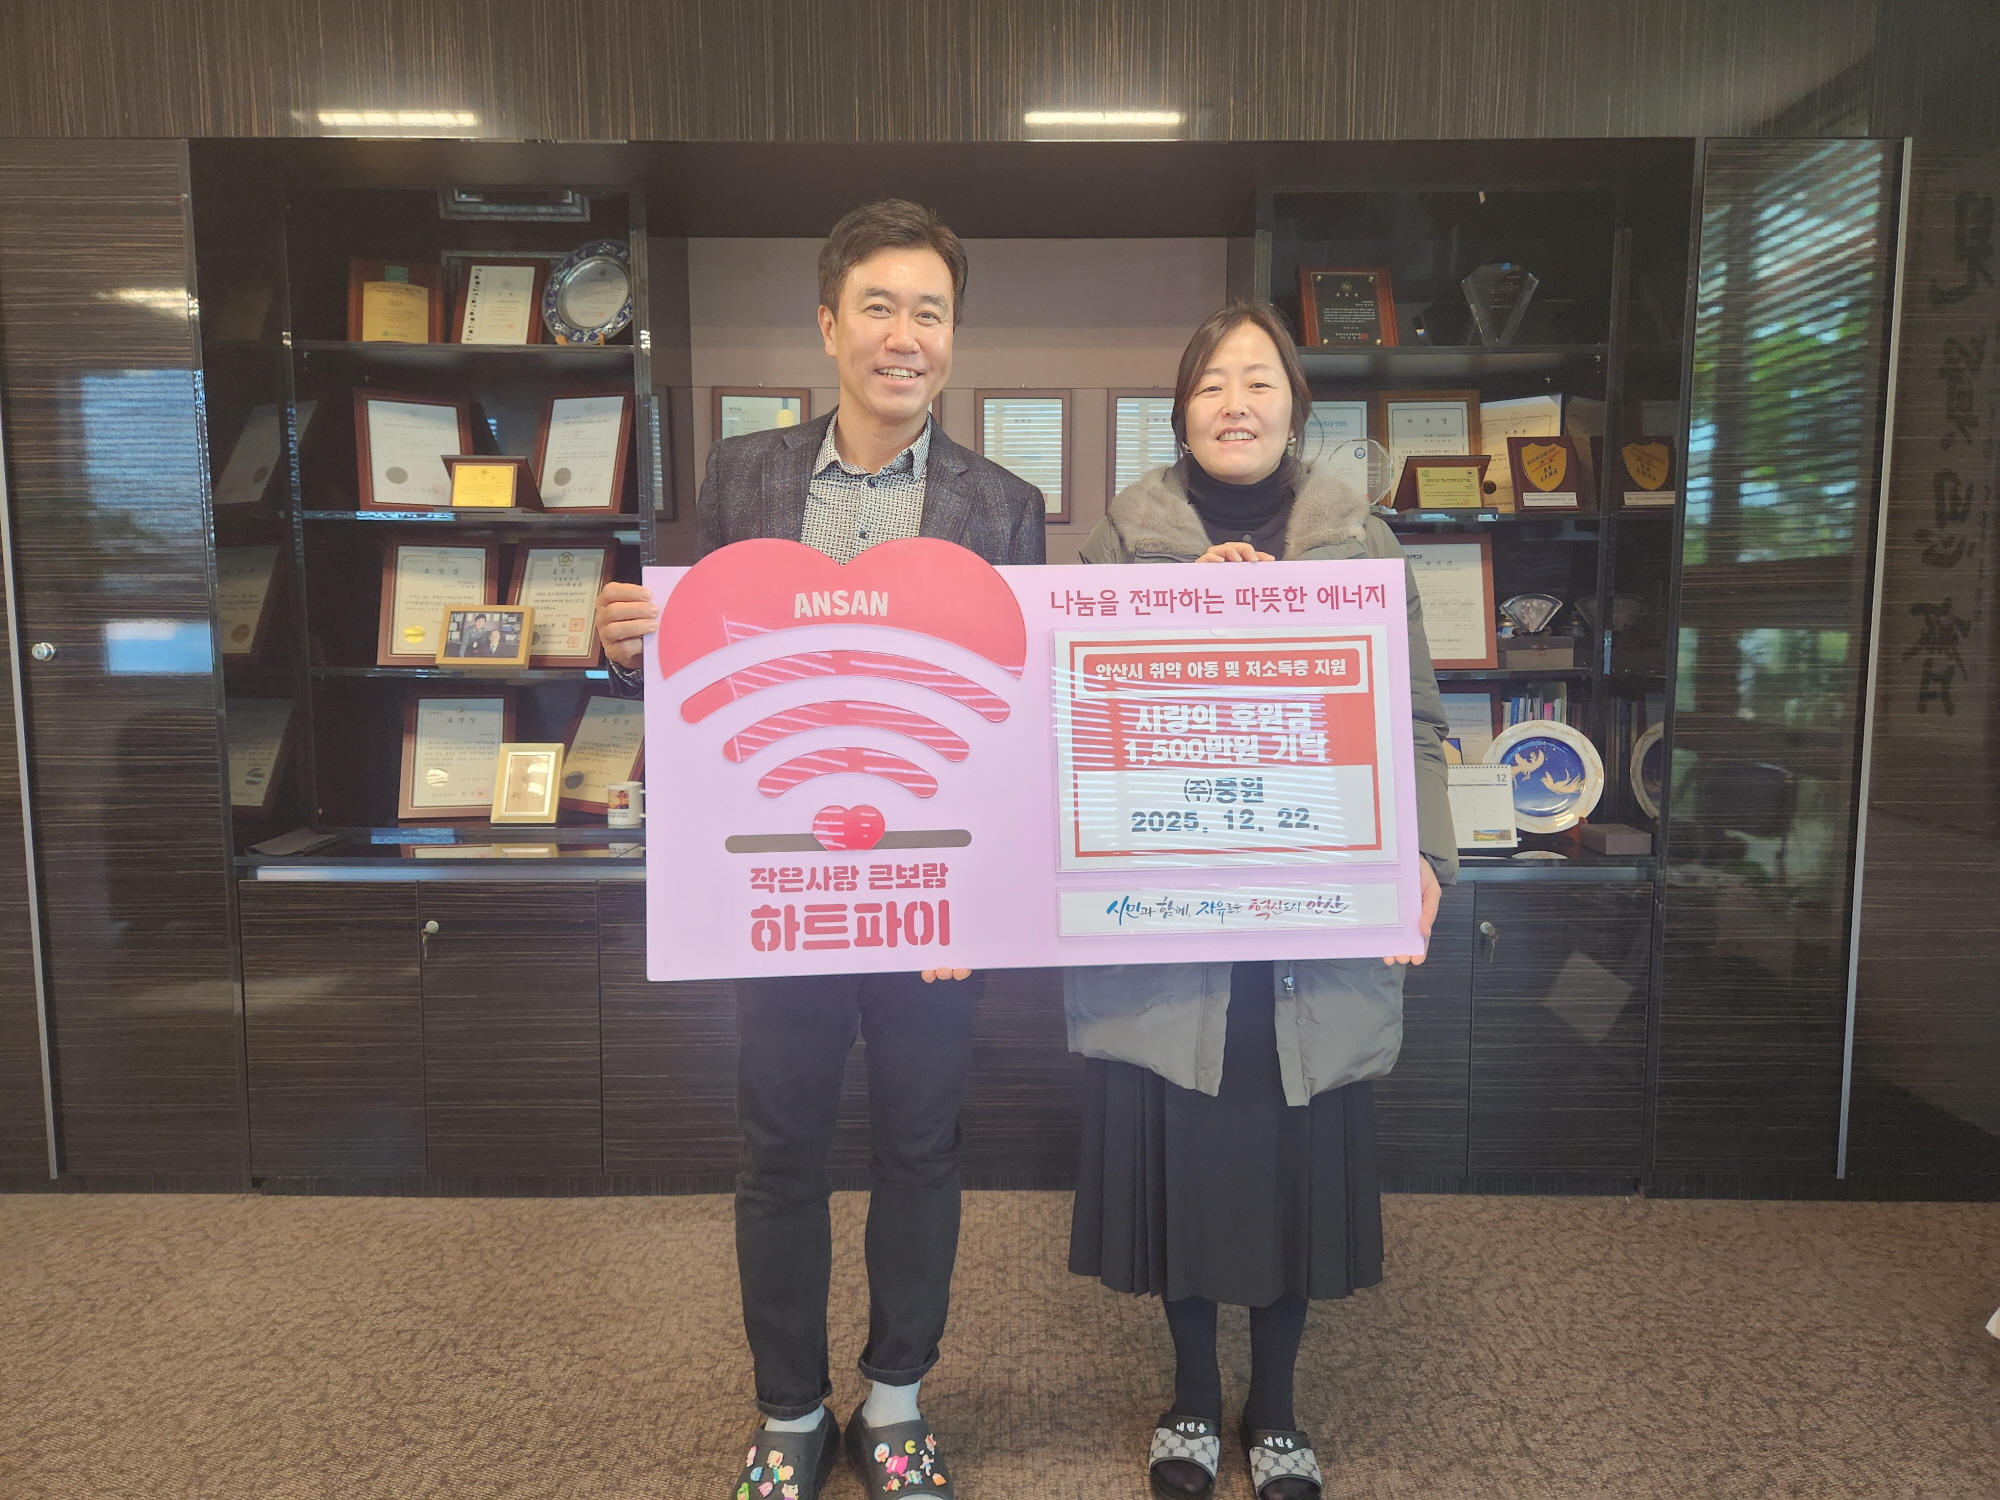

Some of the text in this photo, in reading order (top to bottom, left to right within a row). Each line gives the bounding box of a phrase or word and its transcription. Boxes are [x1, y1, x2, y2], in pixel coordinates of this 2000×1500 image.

[794, 590, 889, 619] ANSAN
[1050, 584, 1386, 617] 나눔을 전파하는 따뜻한 에너지
[1095, 658, 1346, 681] 안산시 취약 아동 및 저소득층 지원
[1135, 702, 1313, 733] 사랑의 후원금
[1124, 732, 1328, 766] 1,500만원 기탁
[1496, 773, 1507, 783] 12
[1131, 807, 1320, 833] 2025. 12. 22.
[750, 862, 949, 894] 작은사랑 큰보람
[1106, 896, 1153, 925] 시민과
[1195, 900, 1242, 925] 자유로운
[1247, 898, 1301, 921] 혁신도시
[1306, 894, 1350, 915] 안산
[750, 899, 951, 952] 하트파이
[1176, 1421, 1207, 1434] 내빈용
[1264, 1436, 1294, 1449] 내빈용
